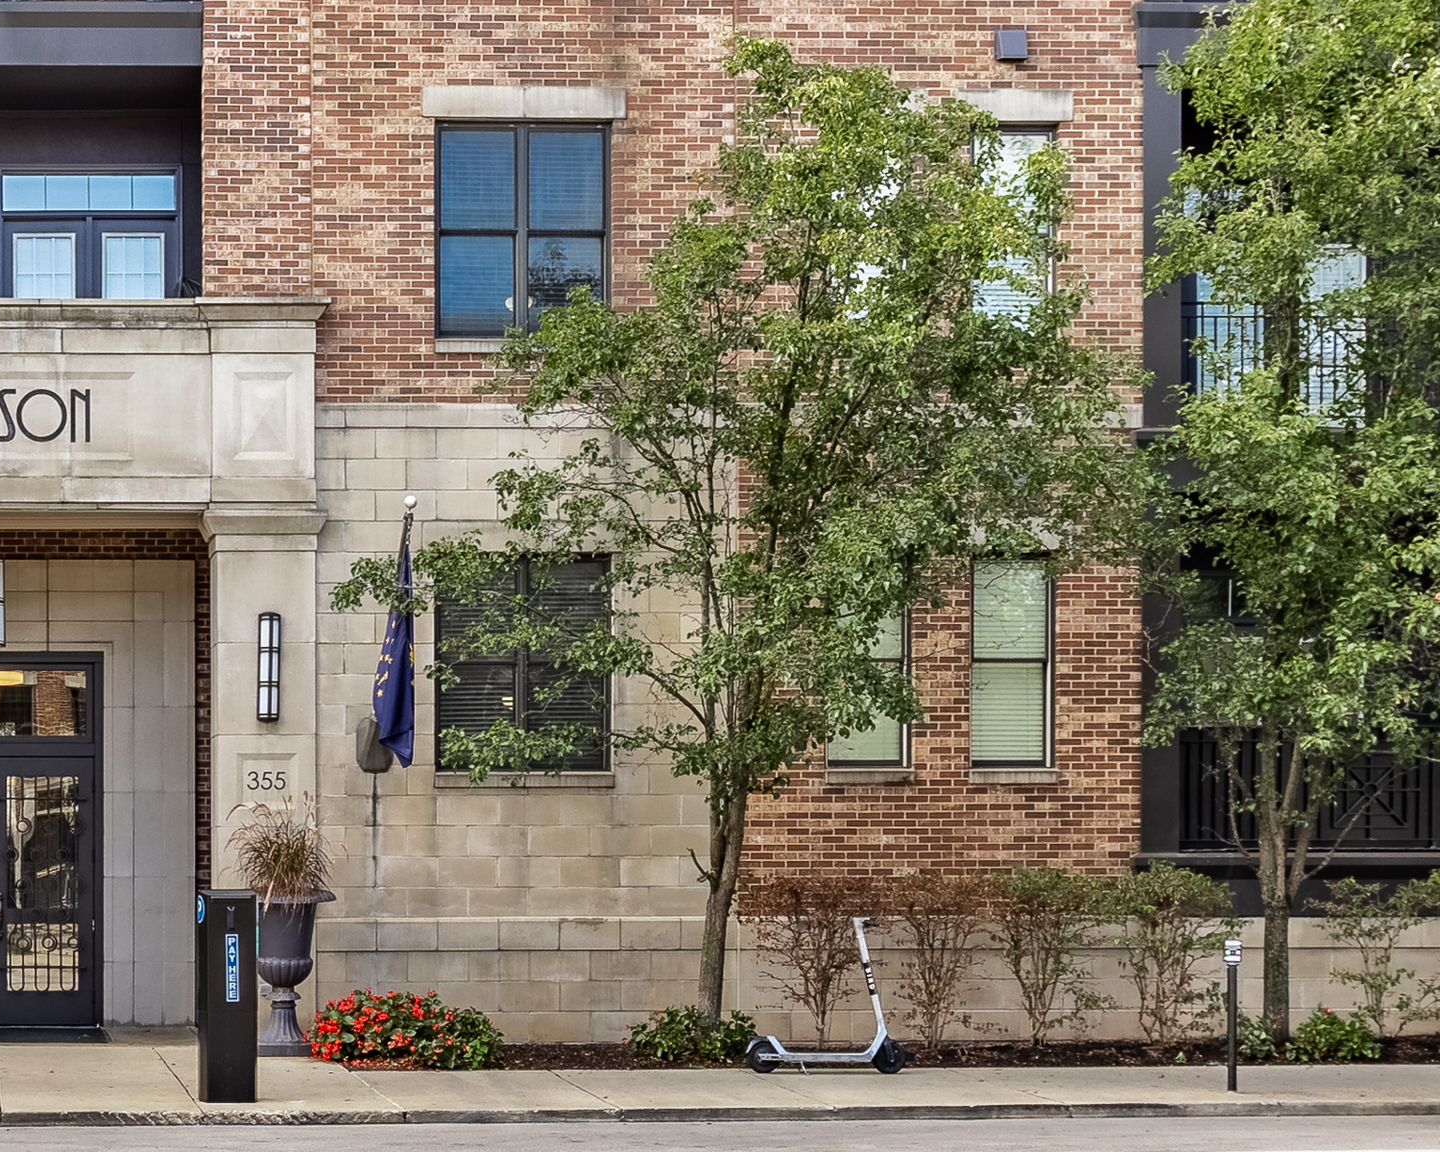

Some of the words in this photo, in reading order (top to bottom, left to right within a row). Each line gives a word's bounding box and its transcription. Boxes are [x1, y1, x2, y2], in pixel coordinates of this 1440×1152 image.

[246, 770, 286, 791] 355
[228, 937, 236, 963] PAY
[228, 965, 237, 999] HERE
